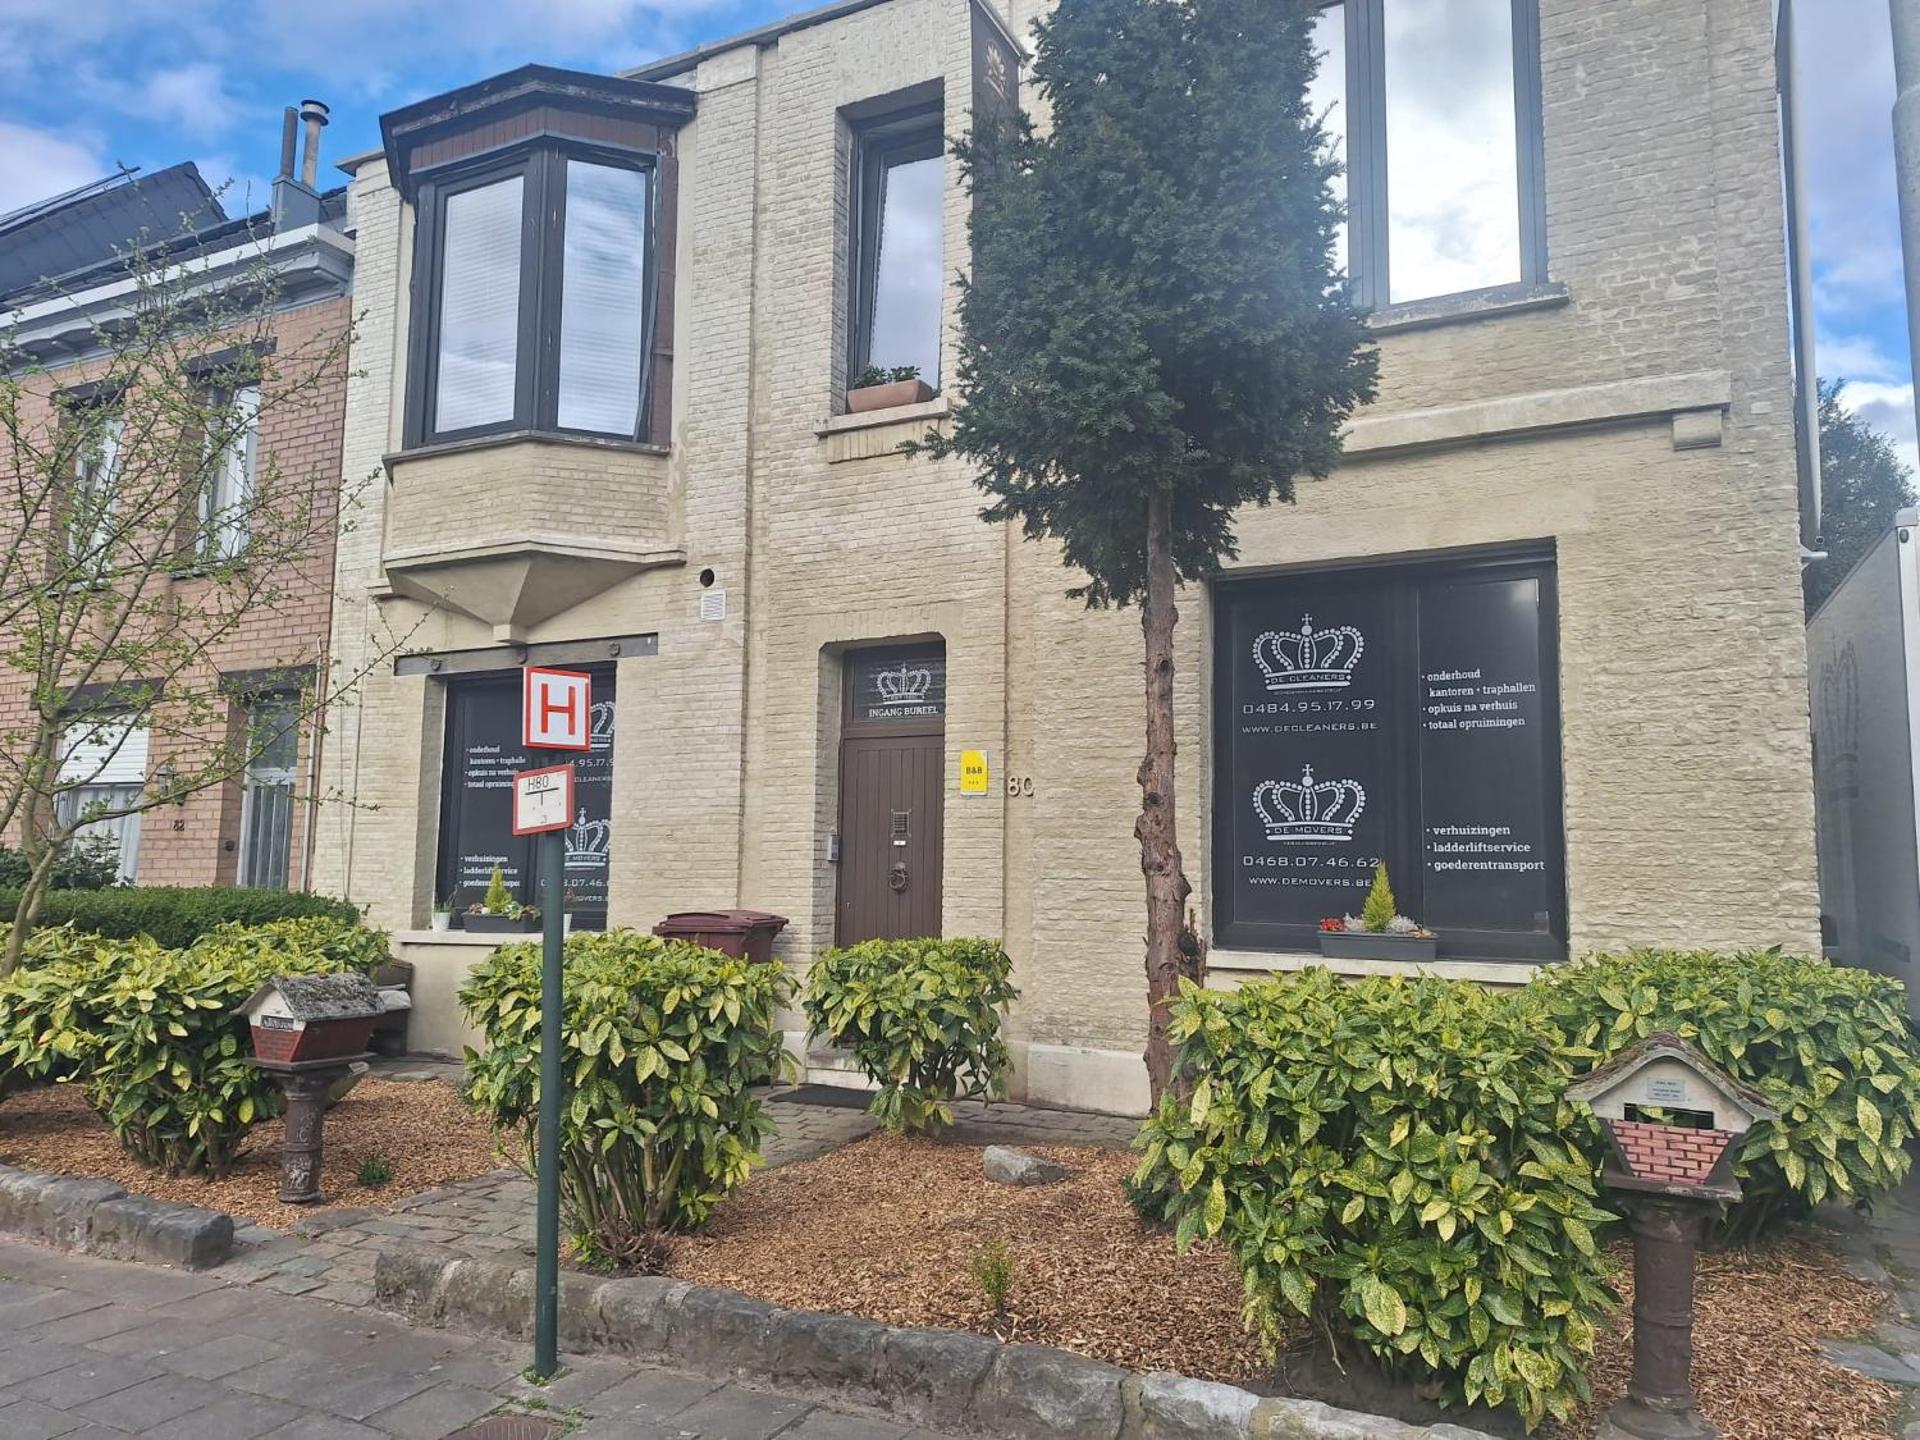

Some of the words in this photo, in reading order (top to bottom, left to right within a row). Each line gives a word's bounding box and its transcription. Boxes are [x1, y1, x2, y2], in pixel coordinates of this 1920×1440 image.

[1289, 674, 1345, 682] CLEANERS
[1427, 668, 1481, 681] onderhoud
[1429, 687, 1474, 697] kantoren
[1482, 682, 1536, 696] traphallen
[541, 683, 576, 736] H
[868, 708, 902, 718] INGANG
[1243, 699, 1376, 714] 0484.95.17.99
[1427, 702, 1462, 715] opkuis
[1464, 704, 1477, 712] na
[1479, 700, 1518, 711] verhuis
[1428, 719, 1458, 730] totaal
[1459, 716, 1526, 730] opruimingen
[528, 775, 549, 790] H80
[1007, 776, 1034, 797] 80
[174, 819, 185, 831] 82
[1295, 826, 1342, 834] MOVERS
[1432, 825, 1511, 838] verhuizingen
[1433, 842, 1531, 852] ladderliftservice
[1243, 856, 1380, 867] 0468.07.46.62
[1434, 859, 1545, 872] goederentransport
[1248, 877, 1372, 887] WWW.DEMOVERS.BE
